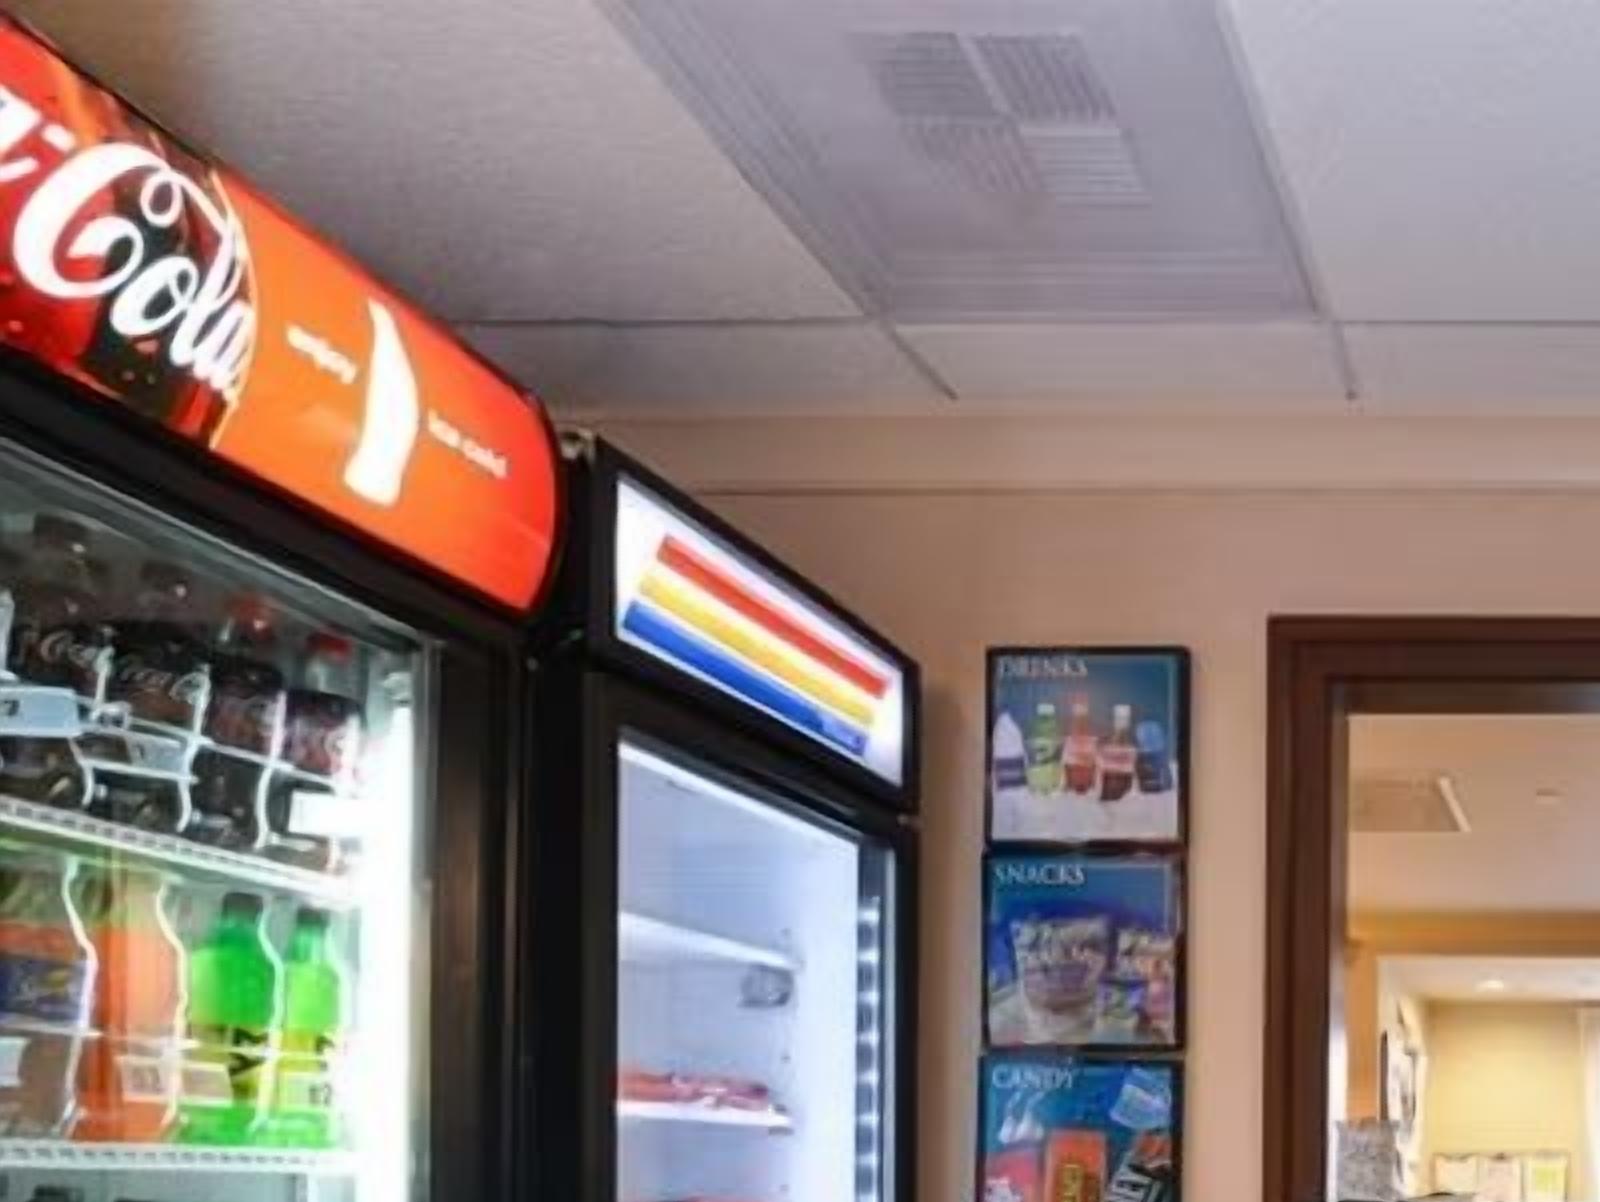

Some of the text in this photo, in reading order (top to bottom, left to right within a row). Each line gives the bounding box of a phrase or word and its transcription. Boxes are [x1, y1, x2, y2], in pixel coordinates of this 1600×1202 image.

[999, 655, 1088, 678] DRINKS
[995, 863, 1086, 886] SNACKS
[991, 1064, 1073, 1089] CANDY
